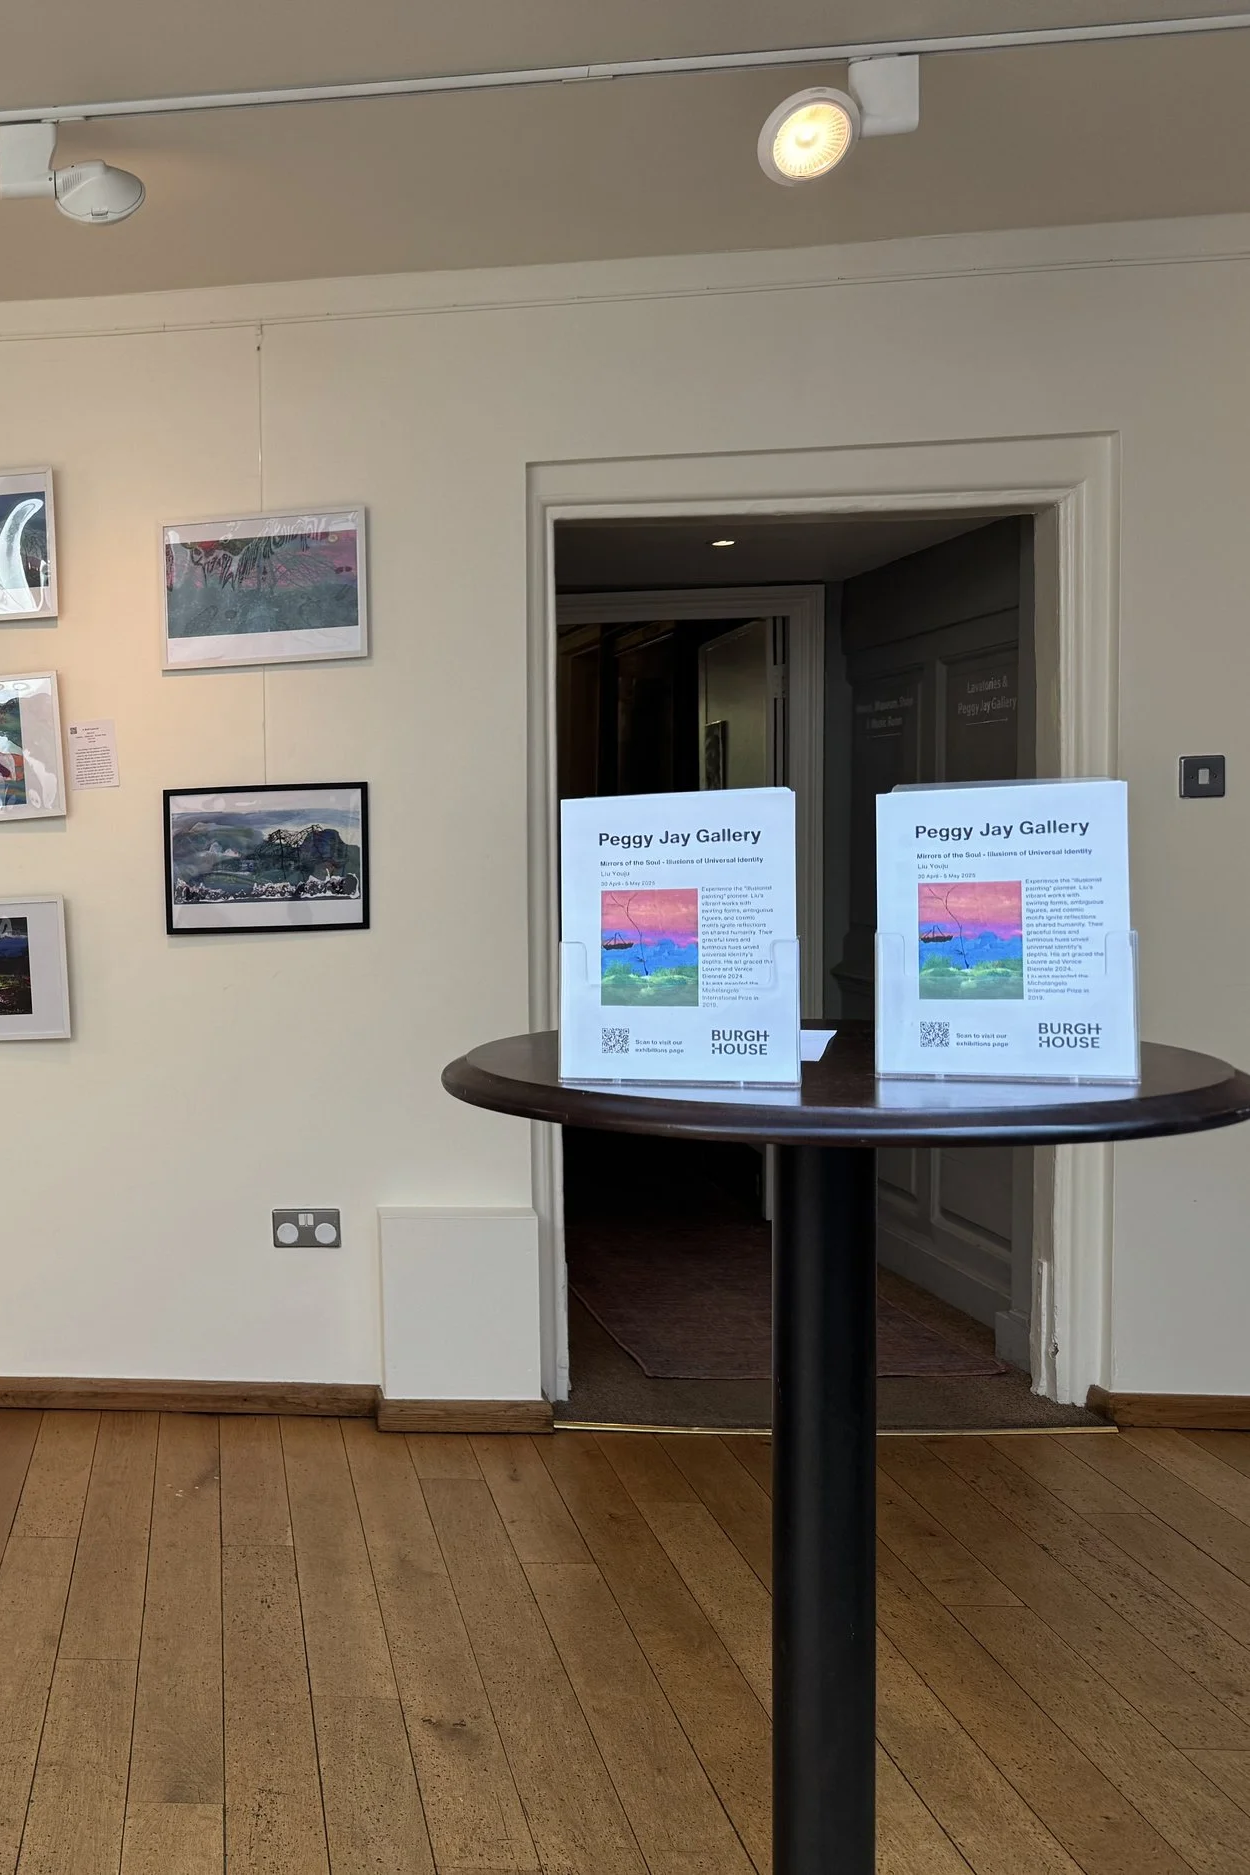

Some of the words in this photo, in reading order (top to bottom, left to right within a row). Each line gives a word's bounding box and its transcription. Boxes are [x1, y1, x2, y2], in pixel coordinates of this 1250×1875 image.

[967, 678, 1000, 693] Lavatories
[1002, 676, 1007, 687] &
[958, 703, 979, 716] Peggy
[980, 700, 991, 713] Jay
[991, 696, 1016, 711] Gallery
[915, 826, 973, 841] Peggy
[980, 823, 1013, 839] Jay
[1020, 820, 1089, 836] Gallery
[599, 833, 653, 849] Peggy
[659, 831, 690, 846] Jay
[696, 829, 761, 845] Gallery
[738, 856, 763, 864] Identity
[1038, 1023, 1101, 1035] BURGH
[712, 1030, 769, 1041] BURGH
[1039, 1037, 1100, 1048] HOUSE
[712, 1043, 767, 1055] HOUSE
